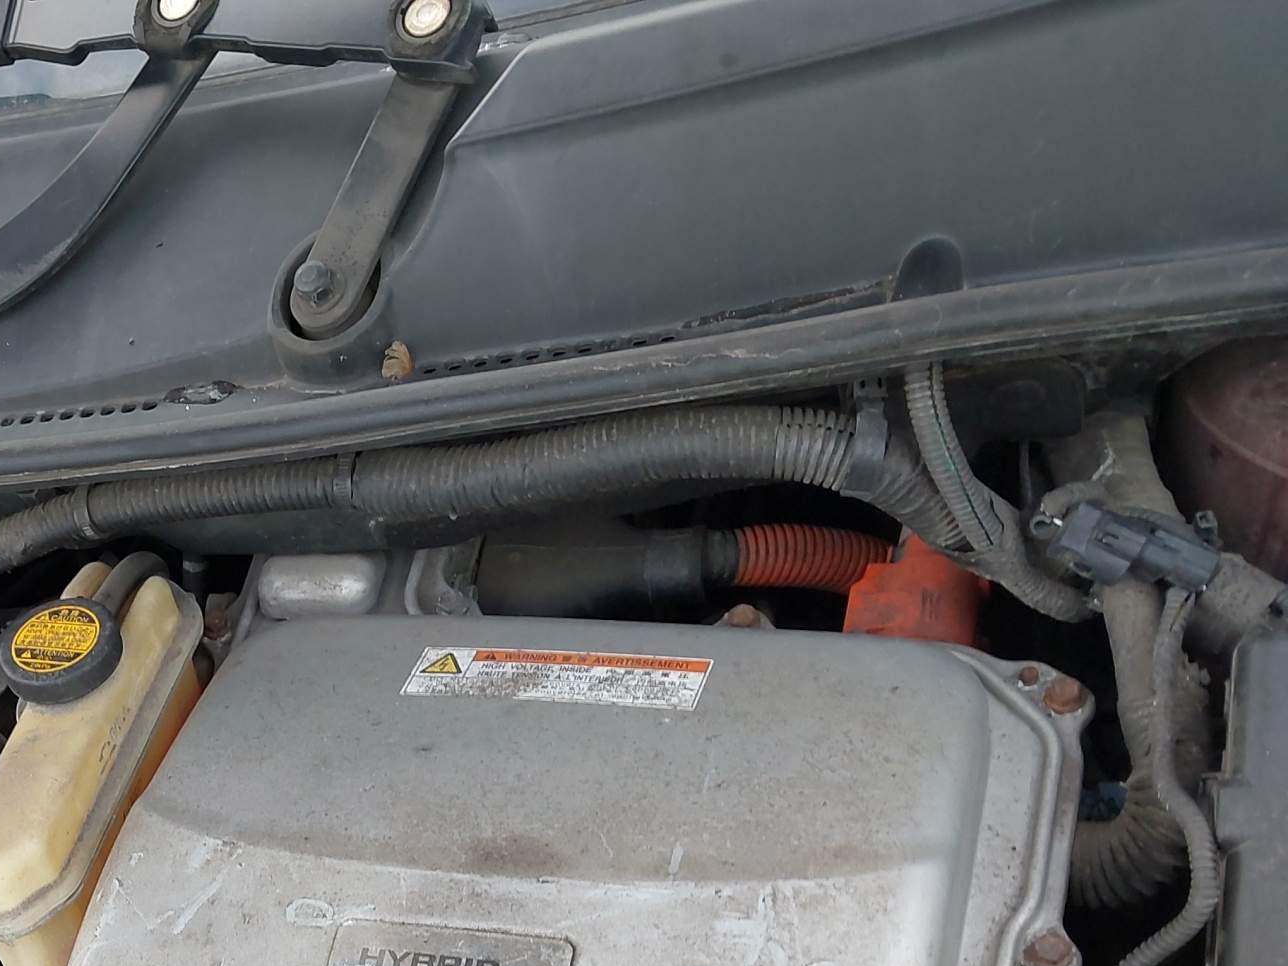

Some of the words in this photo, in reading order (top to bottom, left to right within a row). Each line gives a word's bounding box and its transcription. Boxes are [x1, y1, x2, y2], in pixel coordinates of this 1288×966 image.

[51, 614, 89, 622] CAUTION
[32, 648, 75, 658] ATTENTION
[504, 651, 557, 661] WARNING
[592, 655, 689, 669] AVERTISSEMENT
[559, 665, 592, 673] INSIDE
[477, 670, 507, 678] HAUTE
